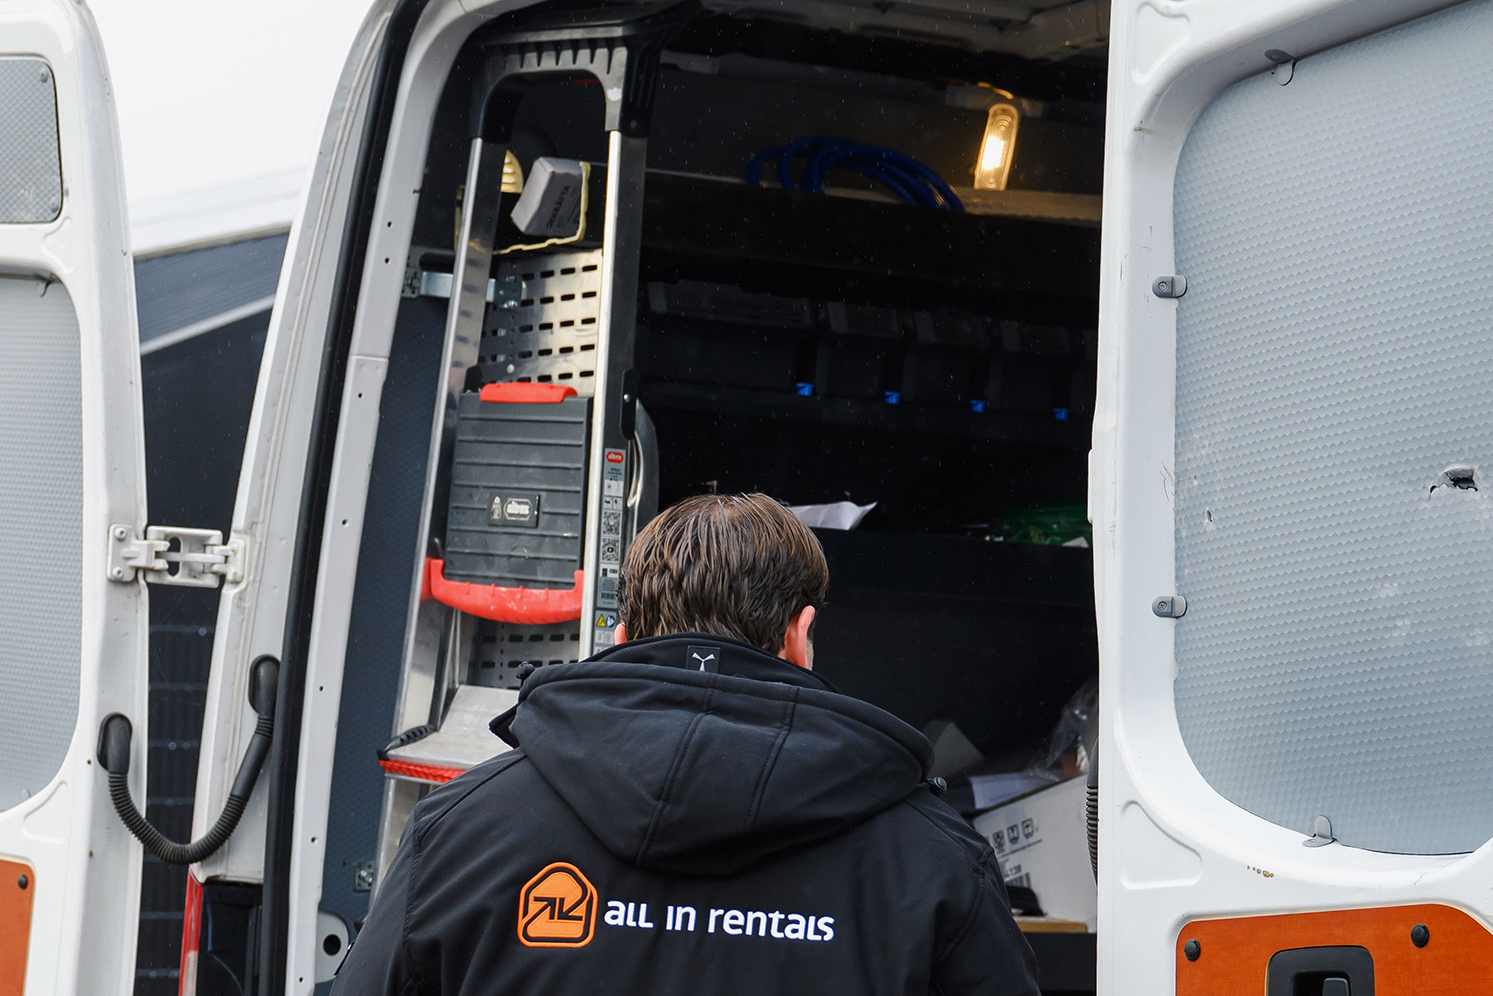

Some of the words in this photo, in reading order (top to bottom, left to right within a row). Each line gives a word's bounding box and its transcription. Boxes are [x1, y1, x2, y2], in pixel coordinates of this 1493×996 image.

[604, 900, 653, 928] all
[665, 905, 697, 931] in
[708, 908, 835, 941] rentals
